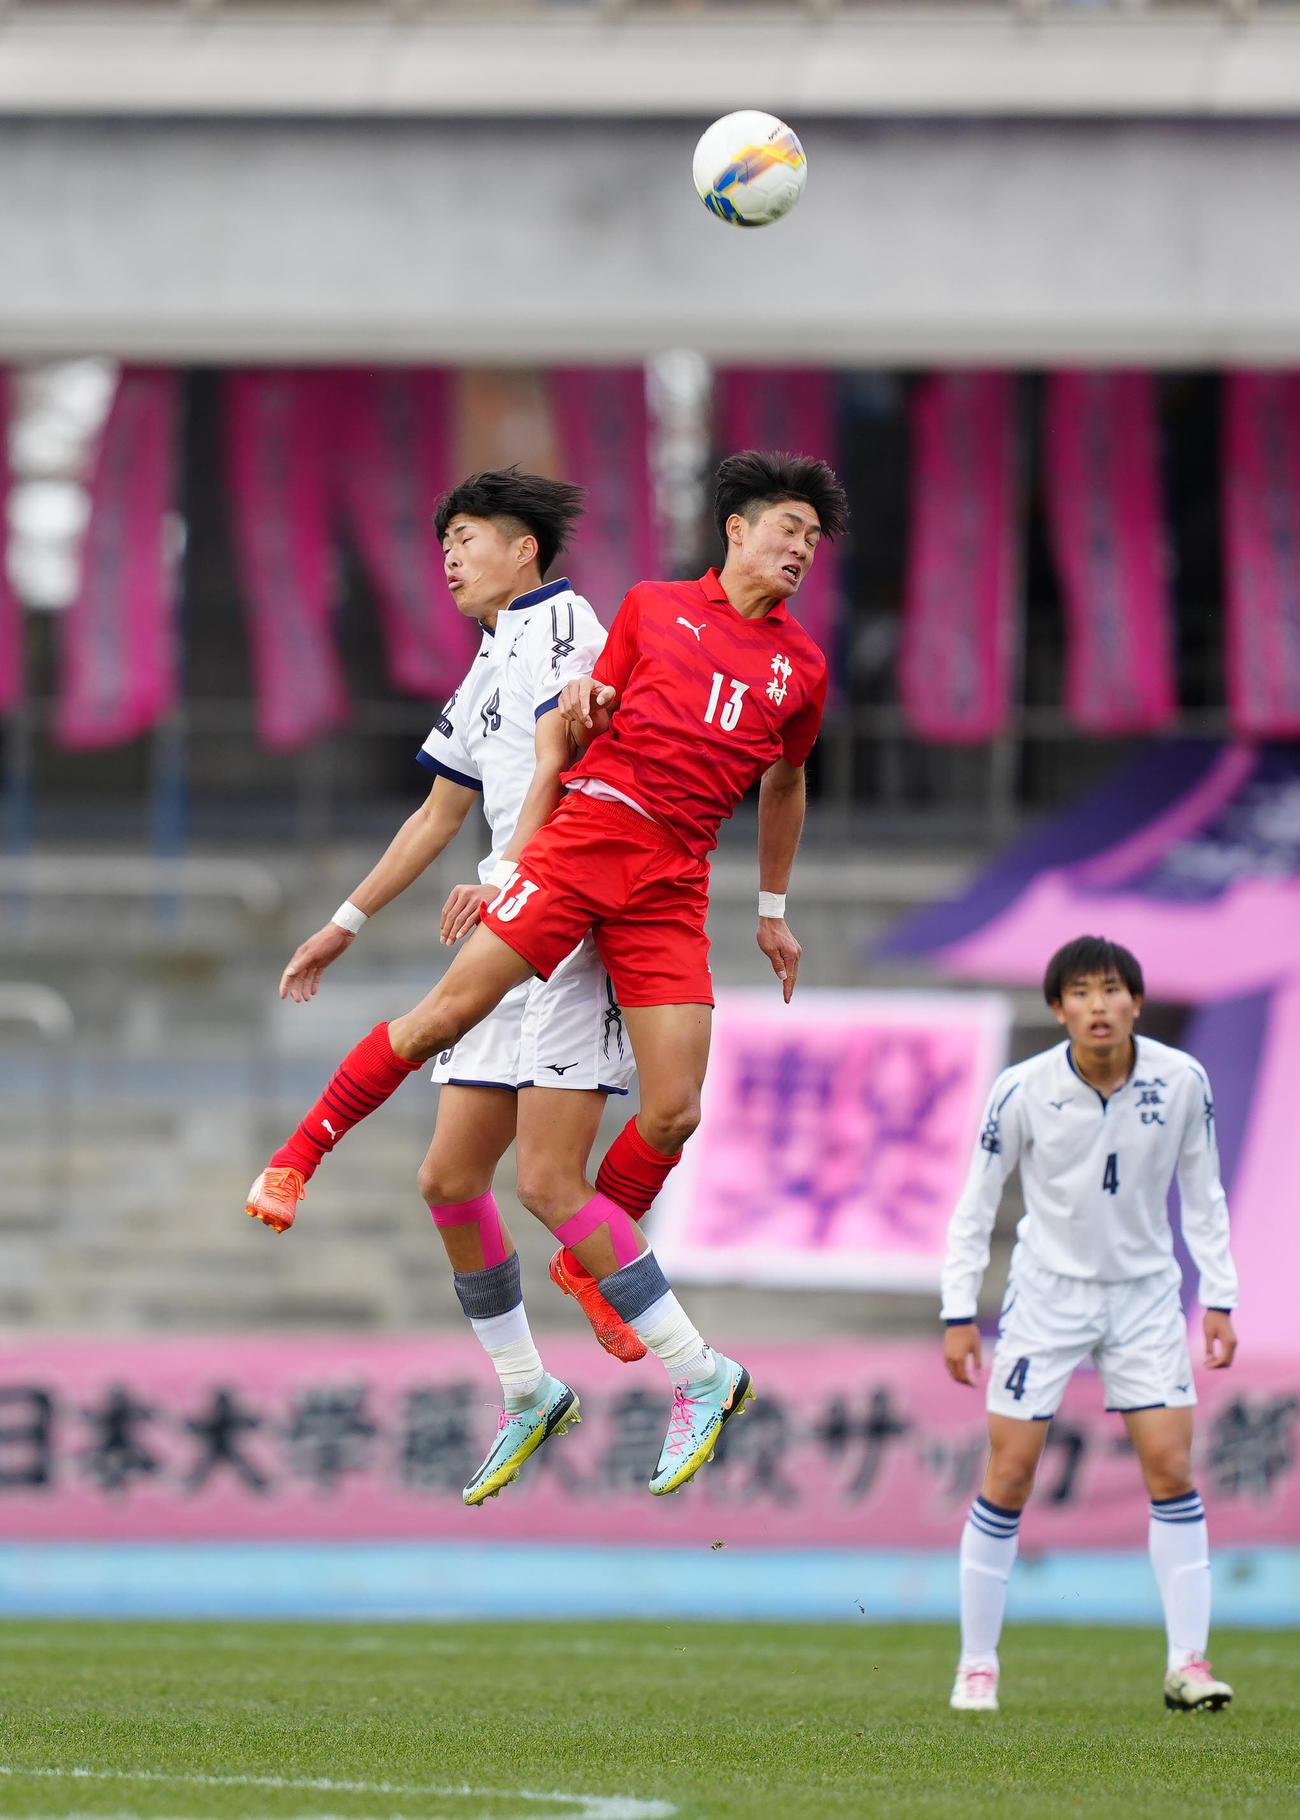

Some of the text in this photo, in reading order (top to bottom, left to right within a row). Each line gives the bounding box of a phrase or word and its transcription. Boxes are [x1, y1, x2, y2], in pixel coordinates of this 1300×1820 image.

[703, 671, 750, 731] 13
[486, 872, 540, 922] 13
[1103, 1152, 1120, 1195] 4
[1004, 1357, 1030, 1401] 4
